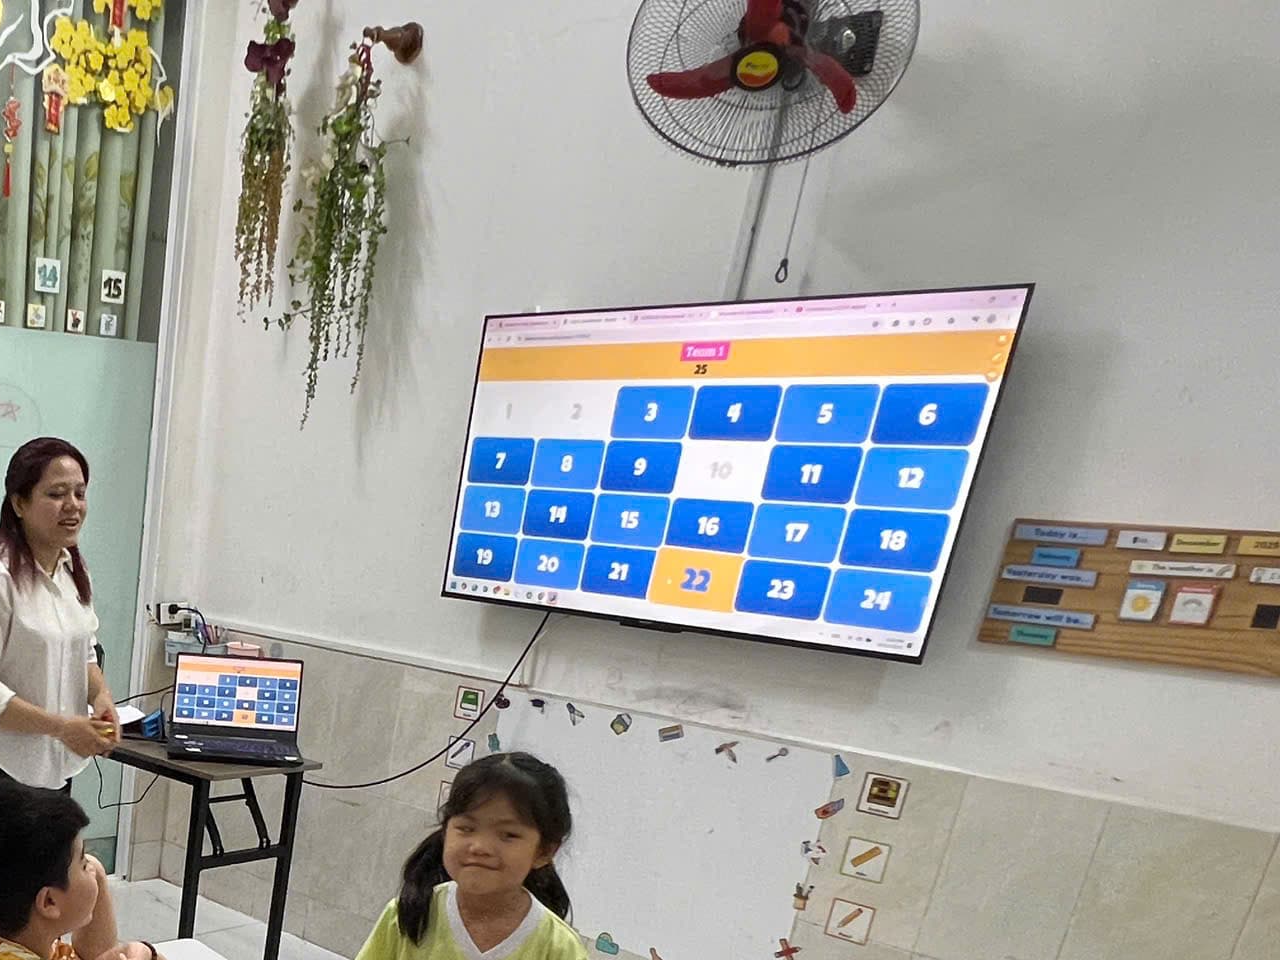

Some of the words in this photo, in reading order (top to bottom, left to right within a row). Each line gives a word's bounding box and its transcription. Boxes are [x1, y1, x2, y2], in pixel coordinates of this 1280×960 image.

[103, 276, 122, 300] 15
[685, 346, 716, 358] Team
[694, 364, 708, 375] 25
[644, 402, 658, 423] 3
[726, 402, 743, 424] 4
[818, 402, 835, 424] 5
[919, 403, 938, 426] 6
[495, 452, 507, 470] 7
[560, 454, 573, 473] 8
[633, 457, 648, 476] 9
[800, 463, 823, 485] 11
[898, 466, 925, 489] 12
[484, 500, 501, 518] 13
[548, 505, 567, 524] 14
[620, 510, 639, 529] 15
[697, 516, 720, 536] 16
[784, 522, 809, 543] 17
[880, 528, 907, 551] 18
[1034, 528, 1066, 539] Today
[476, 548, 493, 566] 19
[537, 554, 559, 573] 20
[607, 561, 629, 581] 21
[680, 567, 712, 592] 22
[1007, 567, 1057, 580] Yesterday
[767, 578, 796, 601] 23
[859, 589, 892, 611] 24
[992, 607, 1041, 619] Tomorrow
[1045, 614, 1063, 622] will
